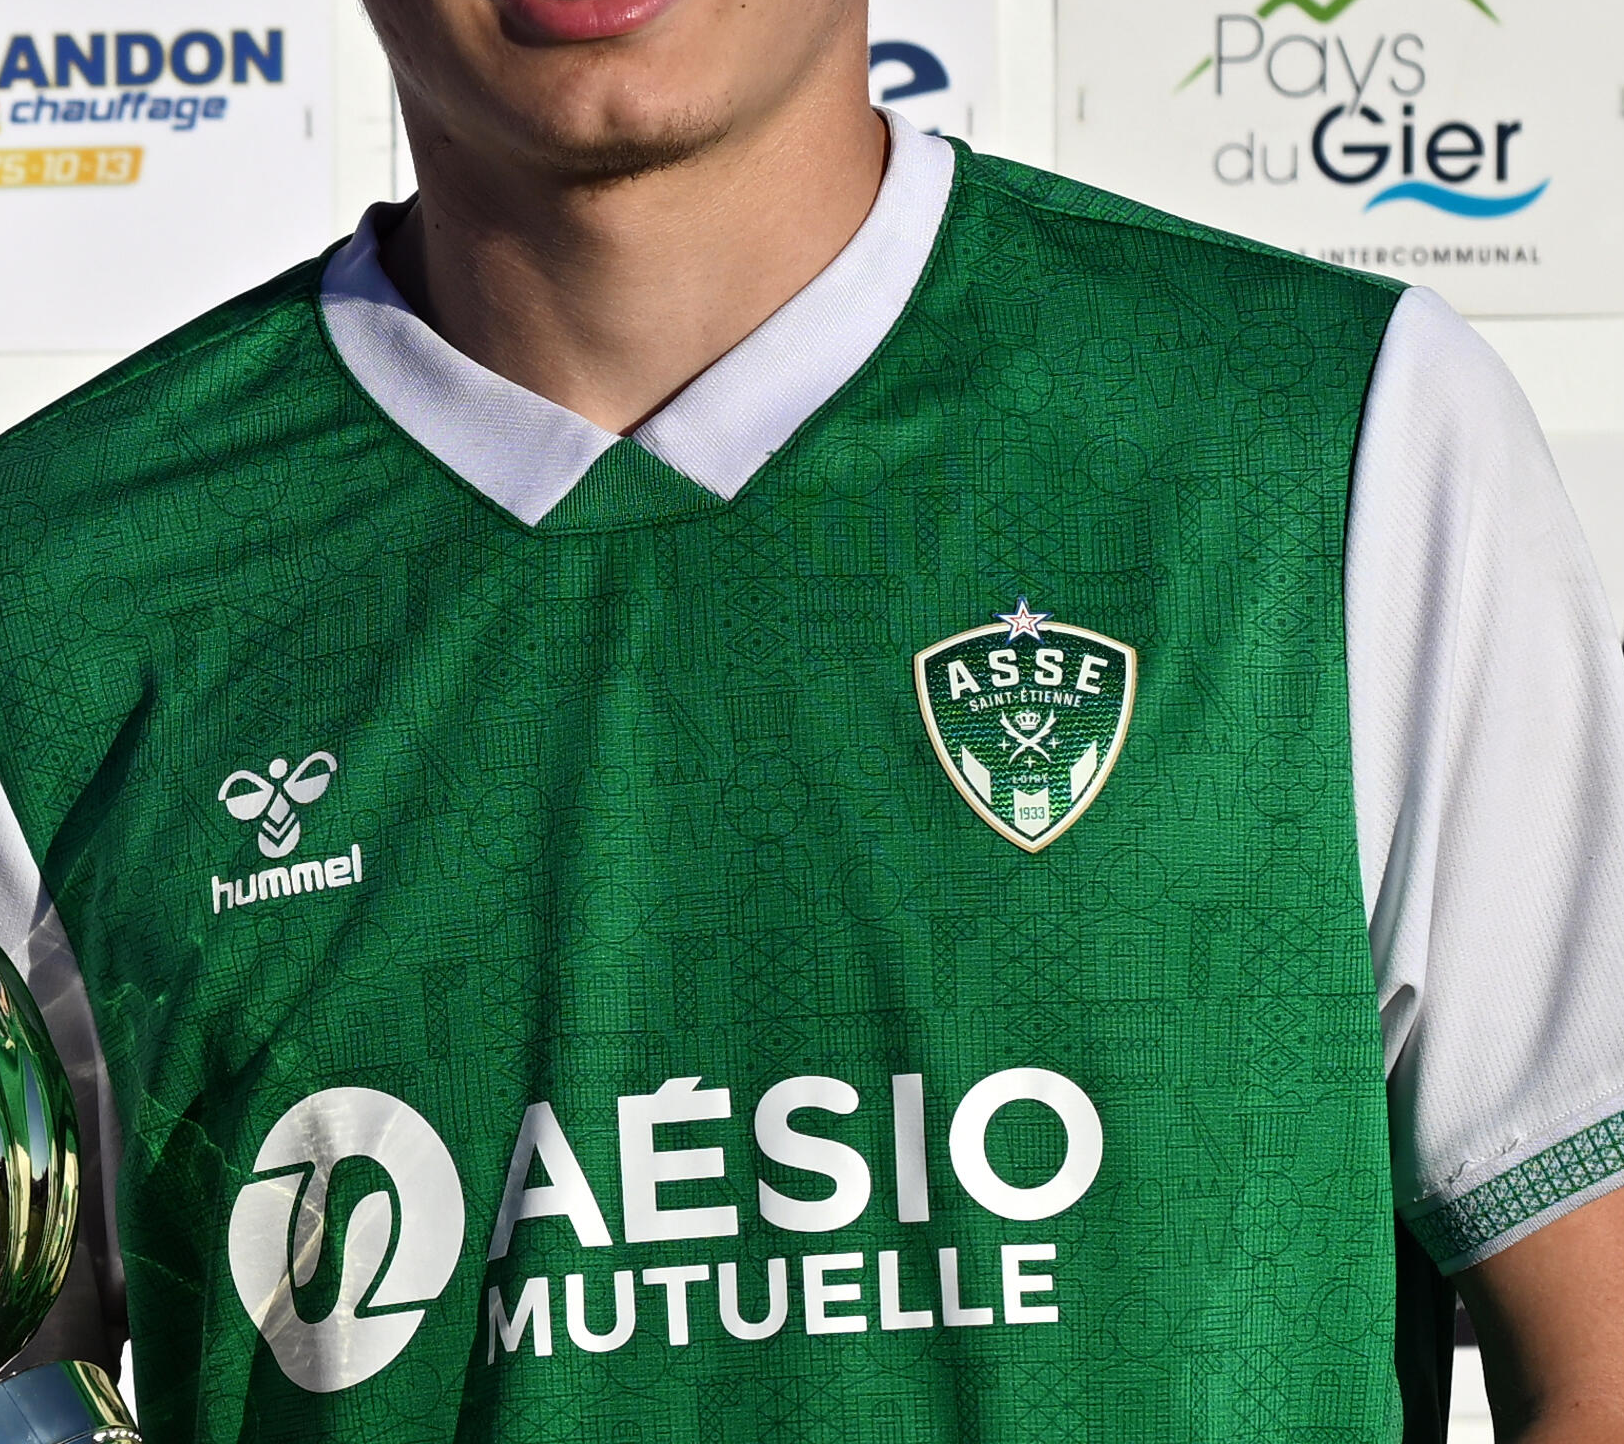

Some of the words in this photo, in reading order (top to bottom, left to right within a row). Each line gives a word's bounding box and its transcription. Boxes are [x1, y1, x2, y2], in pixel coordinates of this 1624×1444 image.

[1214, 13, 1427, 112] Pays
[10, 89, 229, 134] chauffage
[1213, 129, 1299, 187] du
[1311, 102, 1524, 186] Gier
[947, 648, 1109, 701] ASSE
[968, 688, 1083, 713] SAINT-ÉTIENNE
[1018, 806, 1046, 821] 1933
[211, 844, 363, 914] hummel
[487, 1066, 1104, 1262] AÉSIO
[486, 1242, 1060, 1366] MUTUELLE
